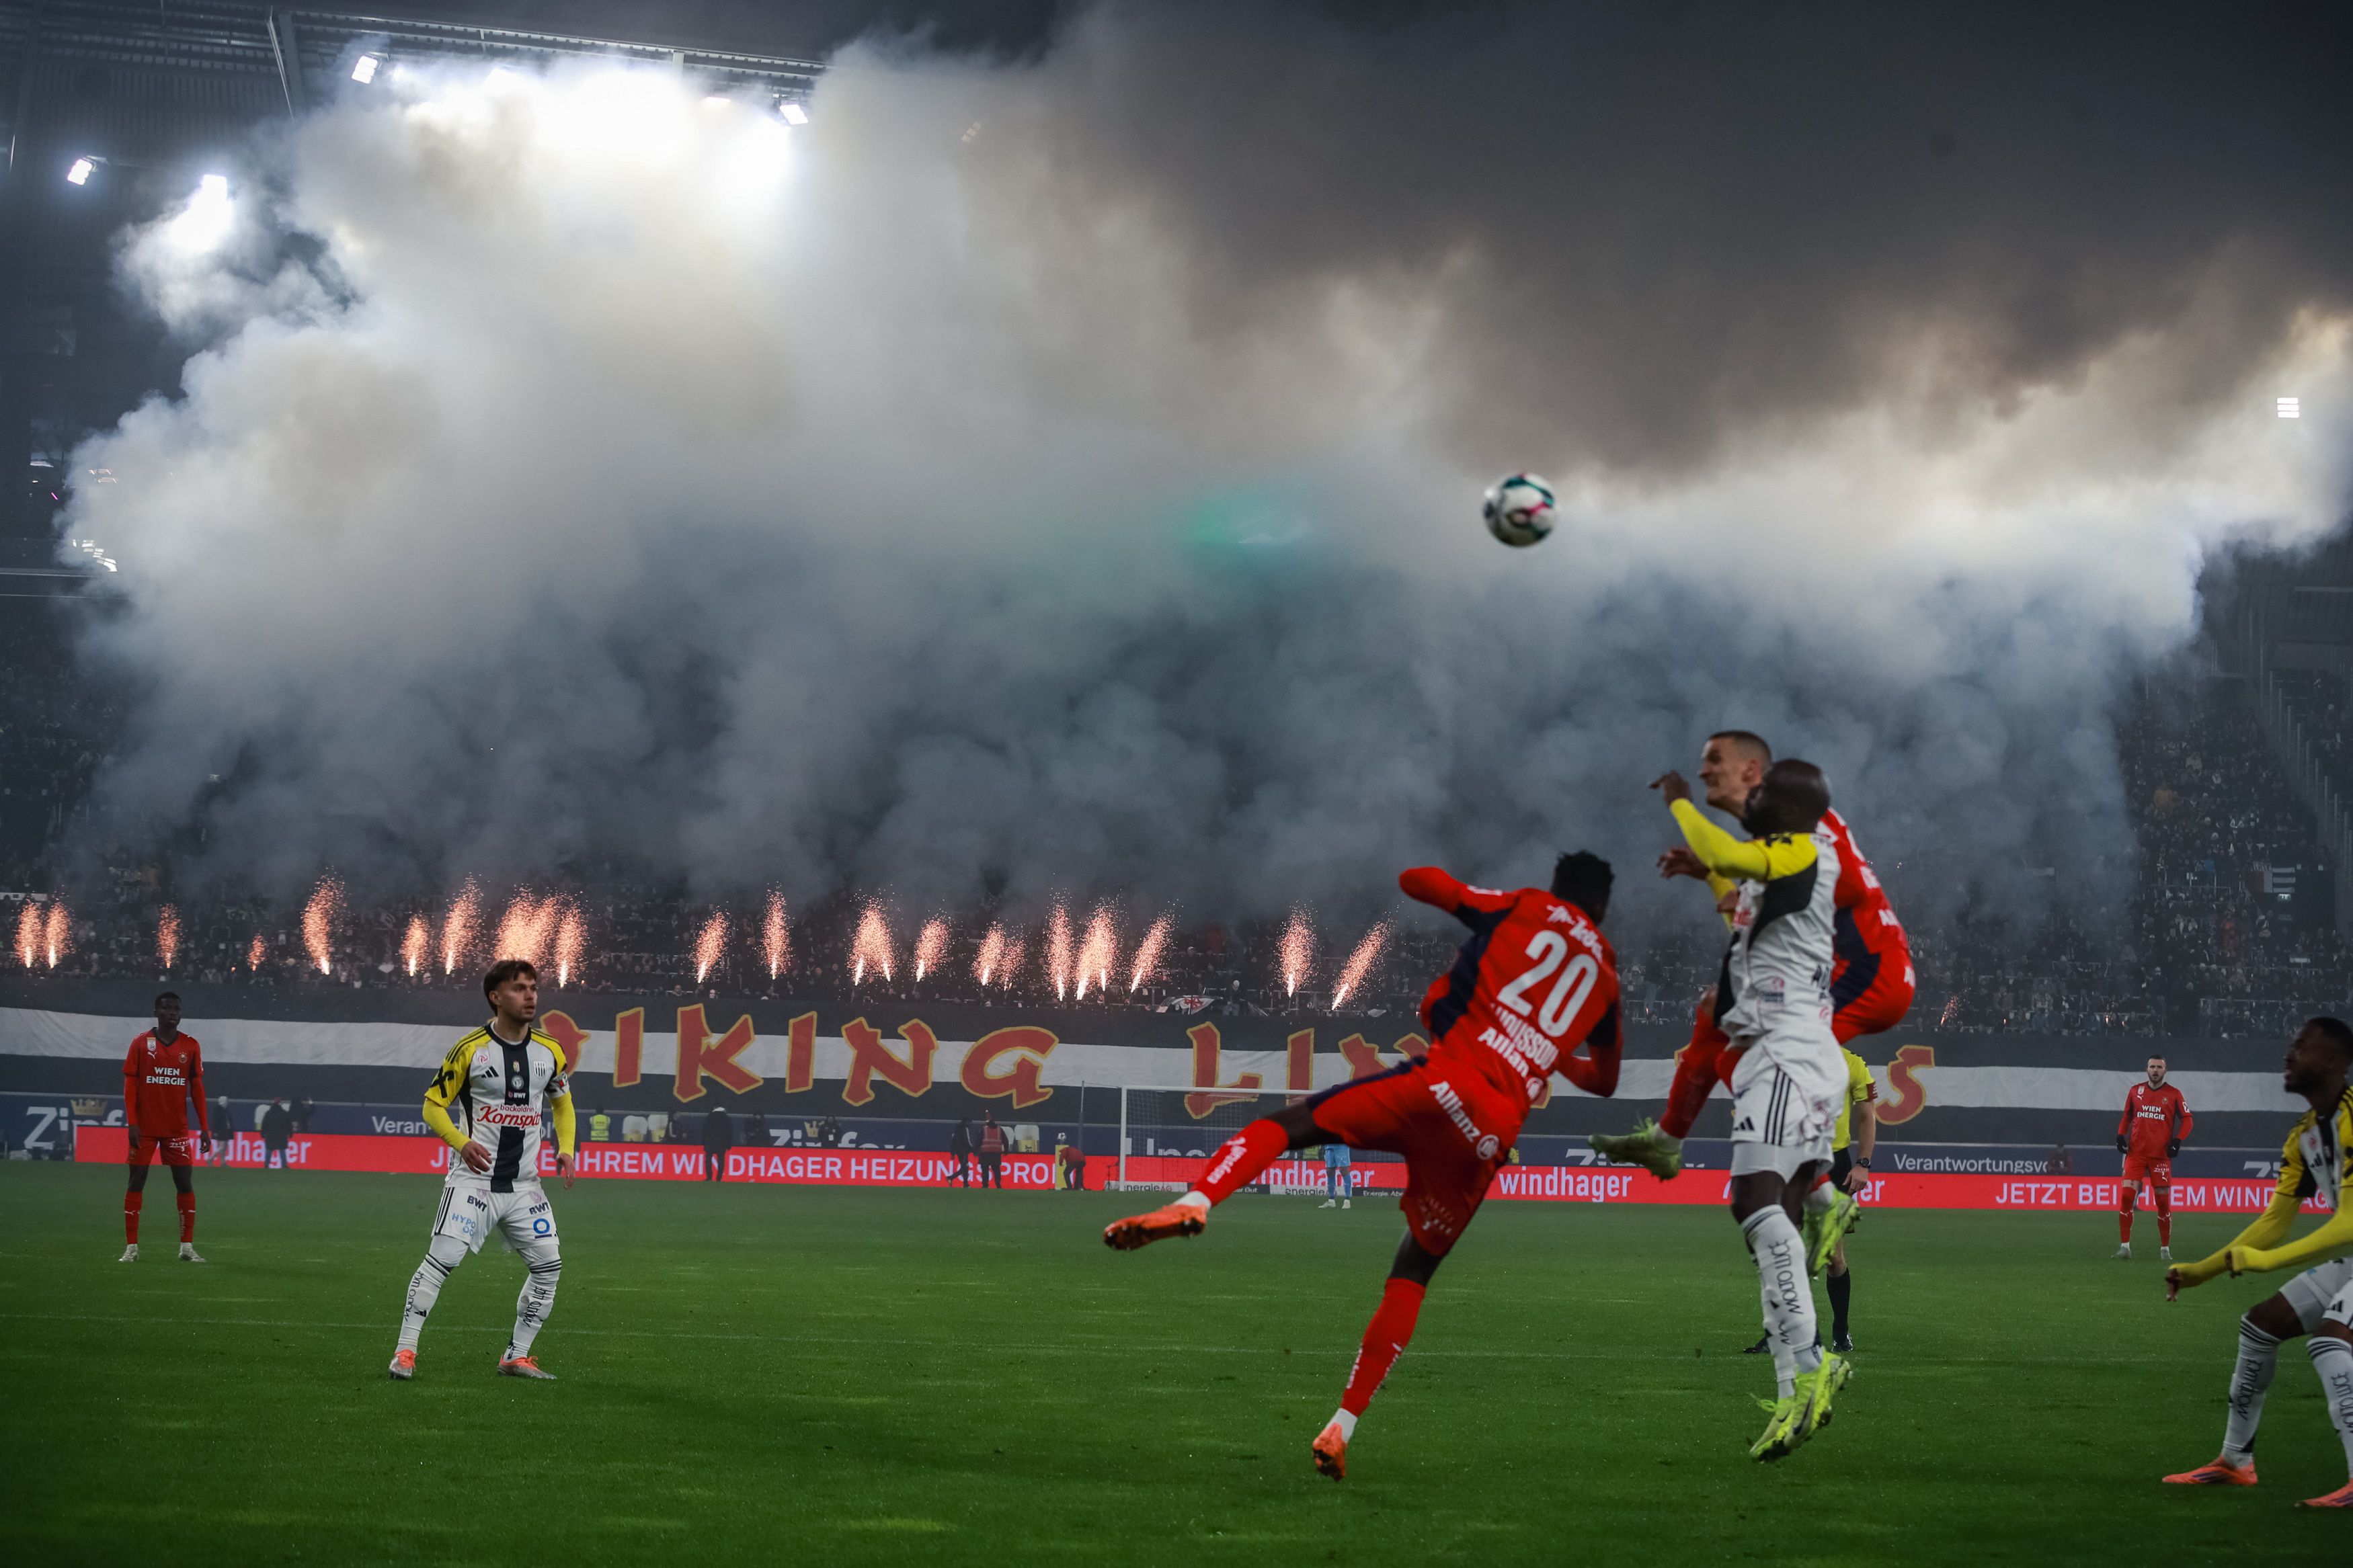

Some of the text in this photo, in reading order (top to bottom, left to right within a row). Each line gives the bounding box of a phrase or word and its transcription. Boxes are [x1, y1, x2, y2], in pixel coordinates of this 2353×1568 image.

[1497, 930, 1599, 1038] 20
[1477, 1026, 1529, 1078] Allian
[146, 1075, 186, 1085] ENERGIE
[154, 1067, 180, 1075] WIEN
[500, 1104, 534, 1113] backaldrin
[1429, 1081, 1481, 1143] Allianz
[2137, 1111, 2165, 1120] ENERGIE
[1499, 1166, 1632, 1203] windhager
[1995, 1182, 2072, 1205] JETZT
[2079, 1184, 2117, 1206] BEI
[467, 1195, 487, 1212] BWT
[452, 1212, 476, 1229] HYPO
[1768, 1239, 1792, 1270] LUCE
[1777, 1270, 1803, 1315] MOLTO
